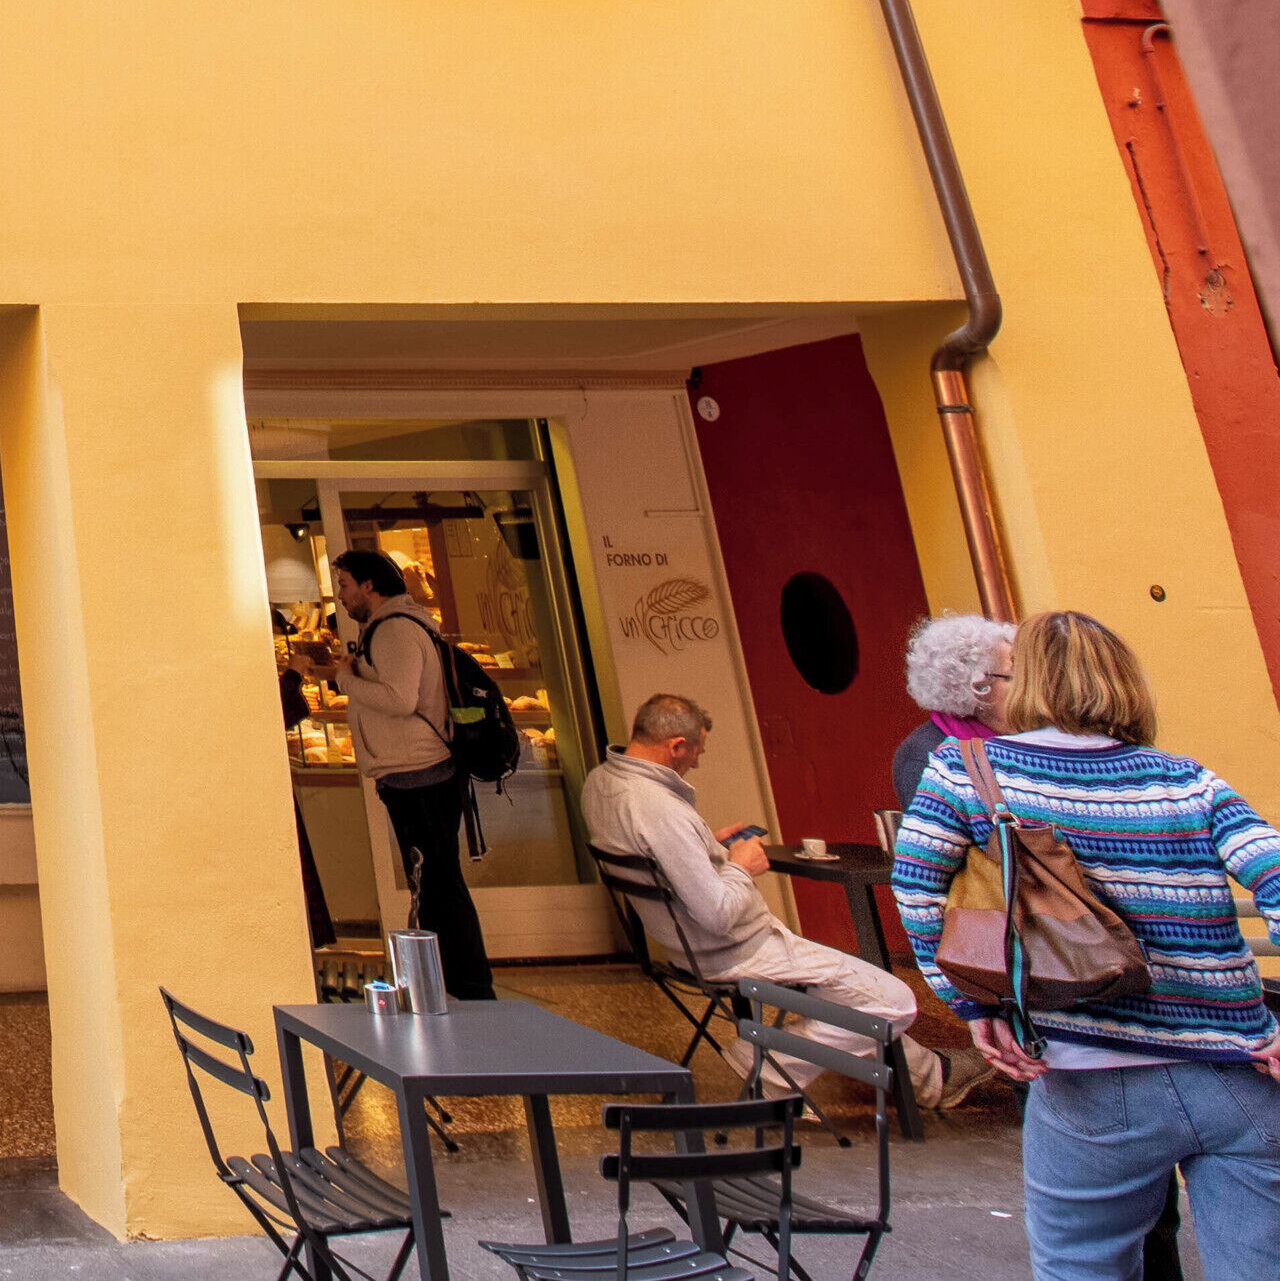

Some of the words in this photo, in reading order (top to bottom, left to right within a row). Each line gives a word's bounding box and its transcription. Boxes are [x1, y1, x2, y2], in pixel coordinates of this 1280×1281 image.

[602, 535, 613, 548] IL
[606, 553, 652, 568] FORNO
[655, 552, 669, 567] DI
